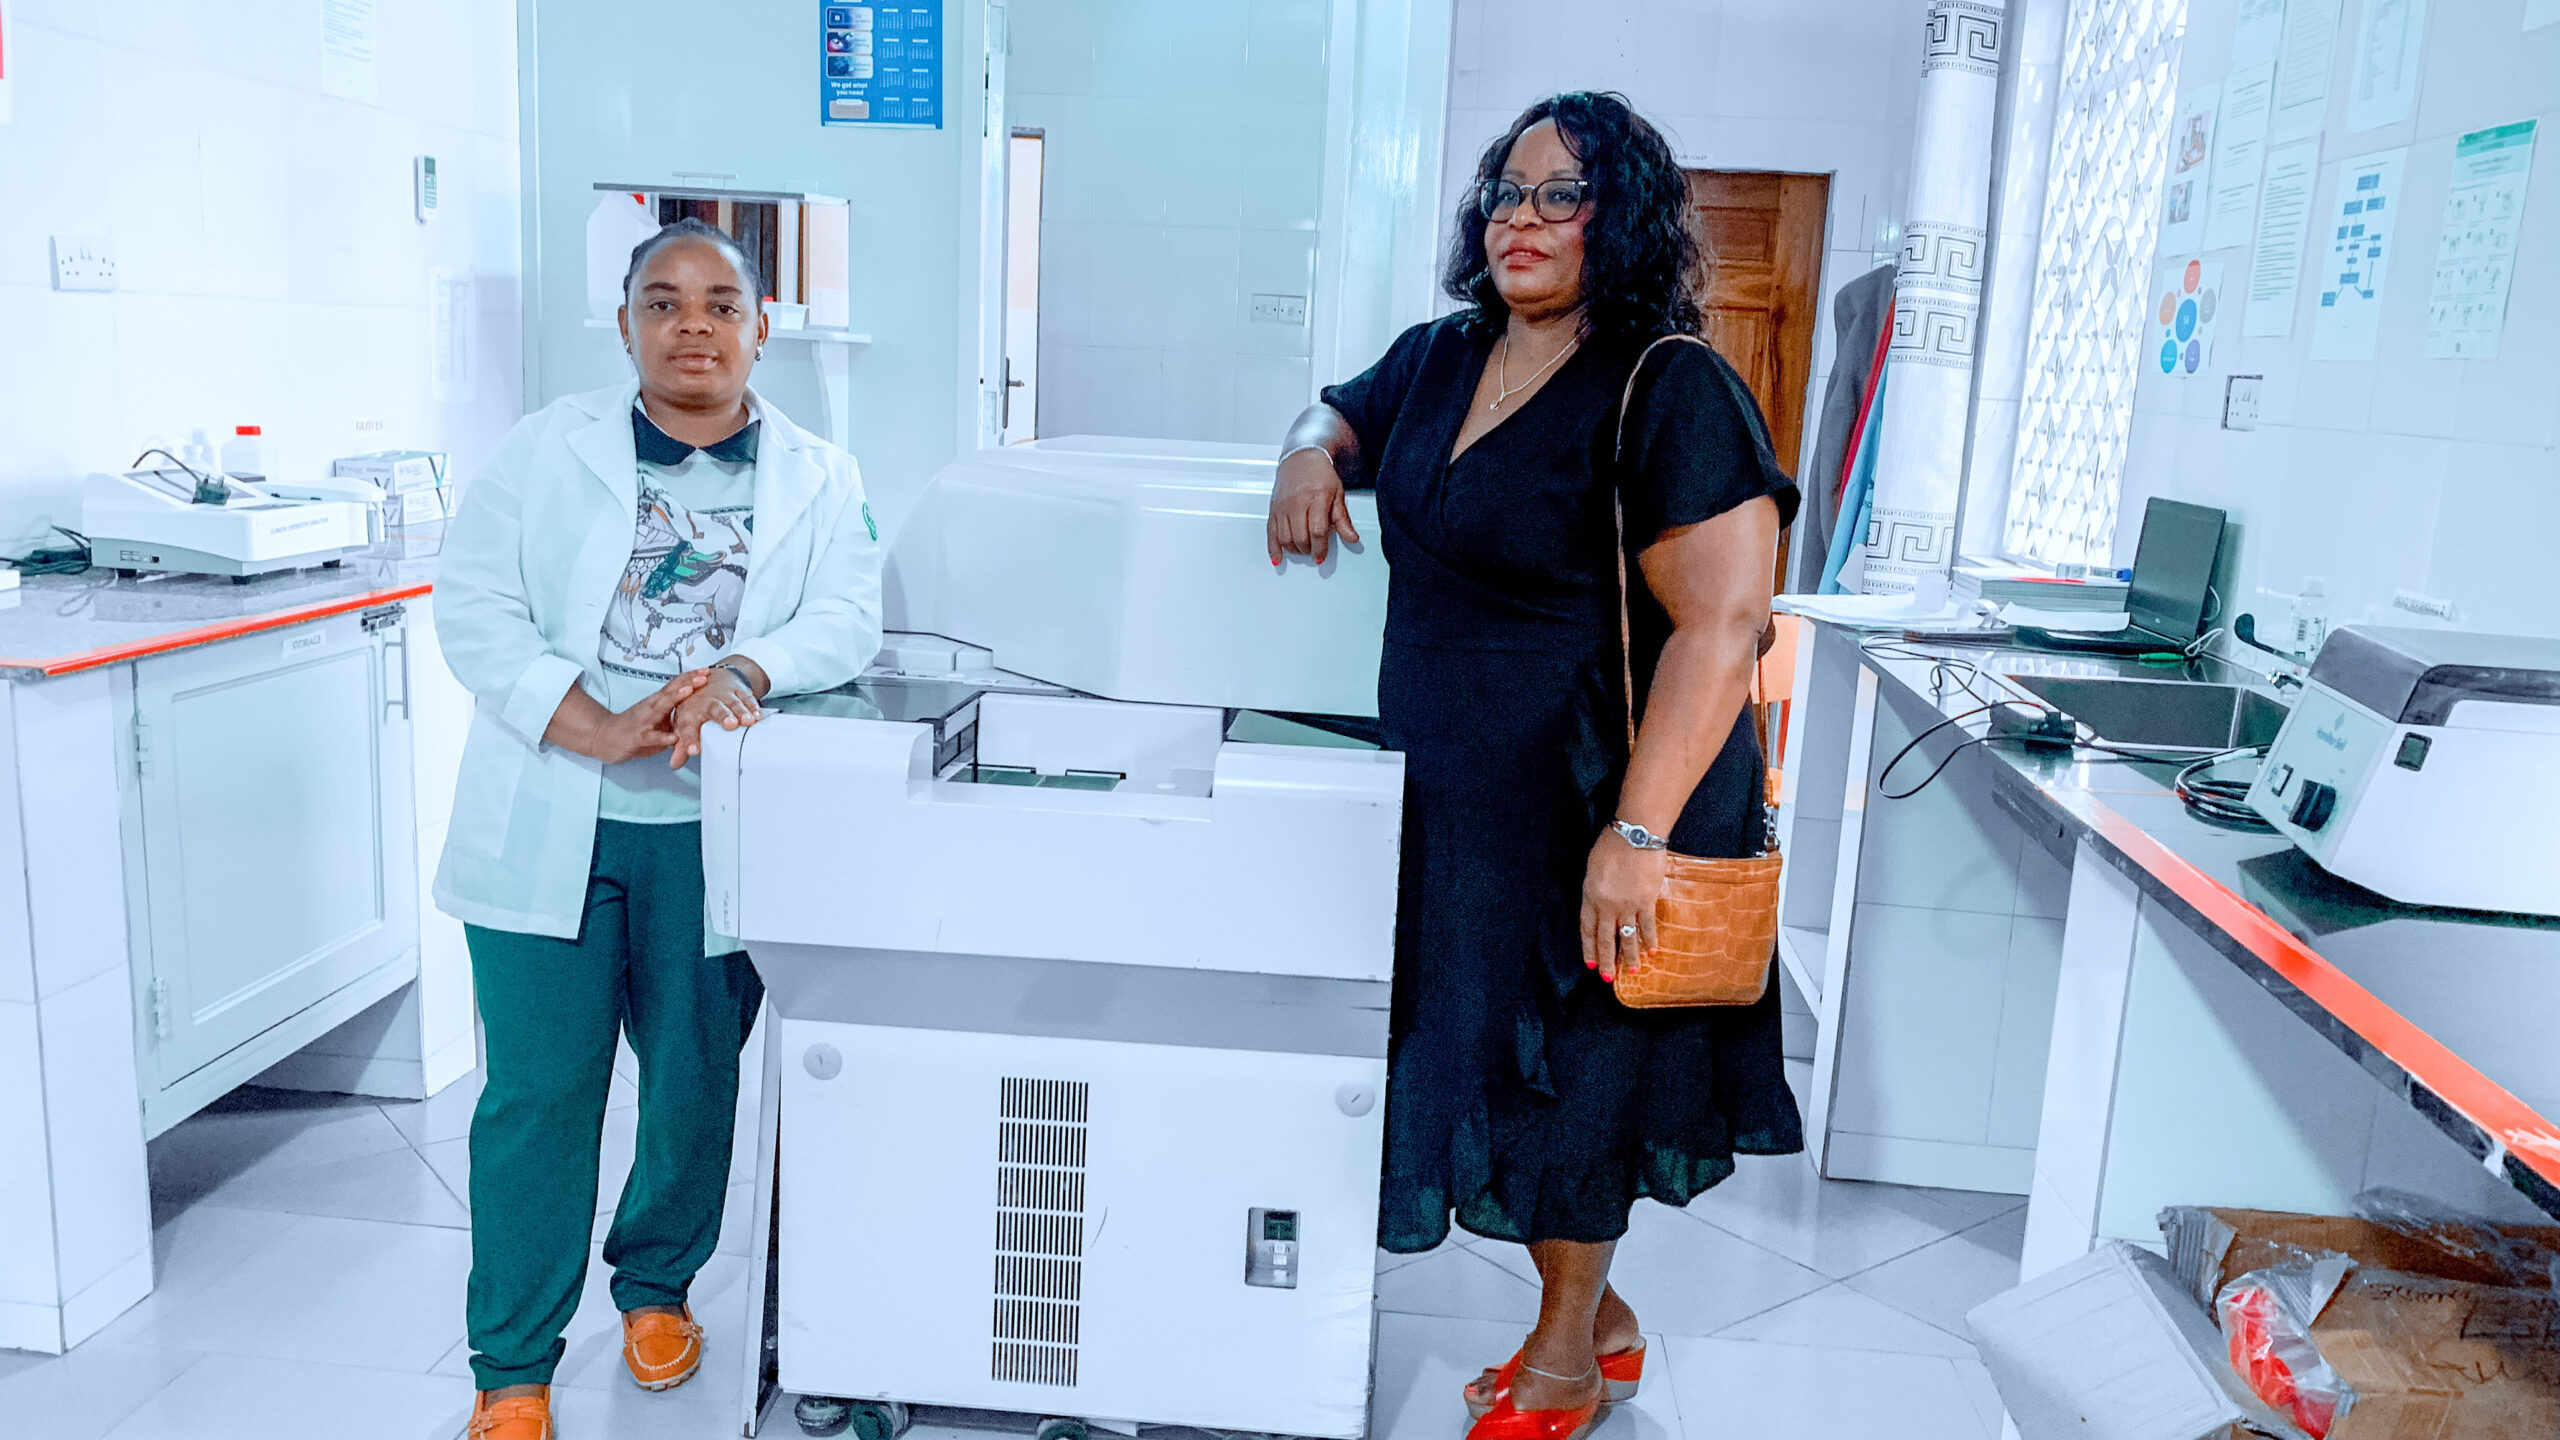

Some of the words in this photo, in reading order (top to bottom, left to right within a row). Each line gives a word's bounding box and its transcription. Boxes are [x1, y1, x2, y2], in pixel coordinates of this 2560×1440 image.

[831, 81, 841, 89] We
[842, 81, 852, 90] got
[852, 81, 868, 89] what
[836, 88, 849, 97] you
[849, 88, 864, 96] need
[355, 420, 384, 431] GLOVES
[292, 634, 321, 650] STORAGE
